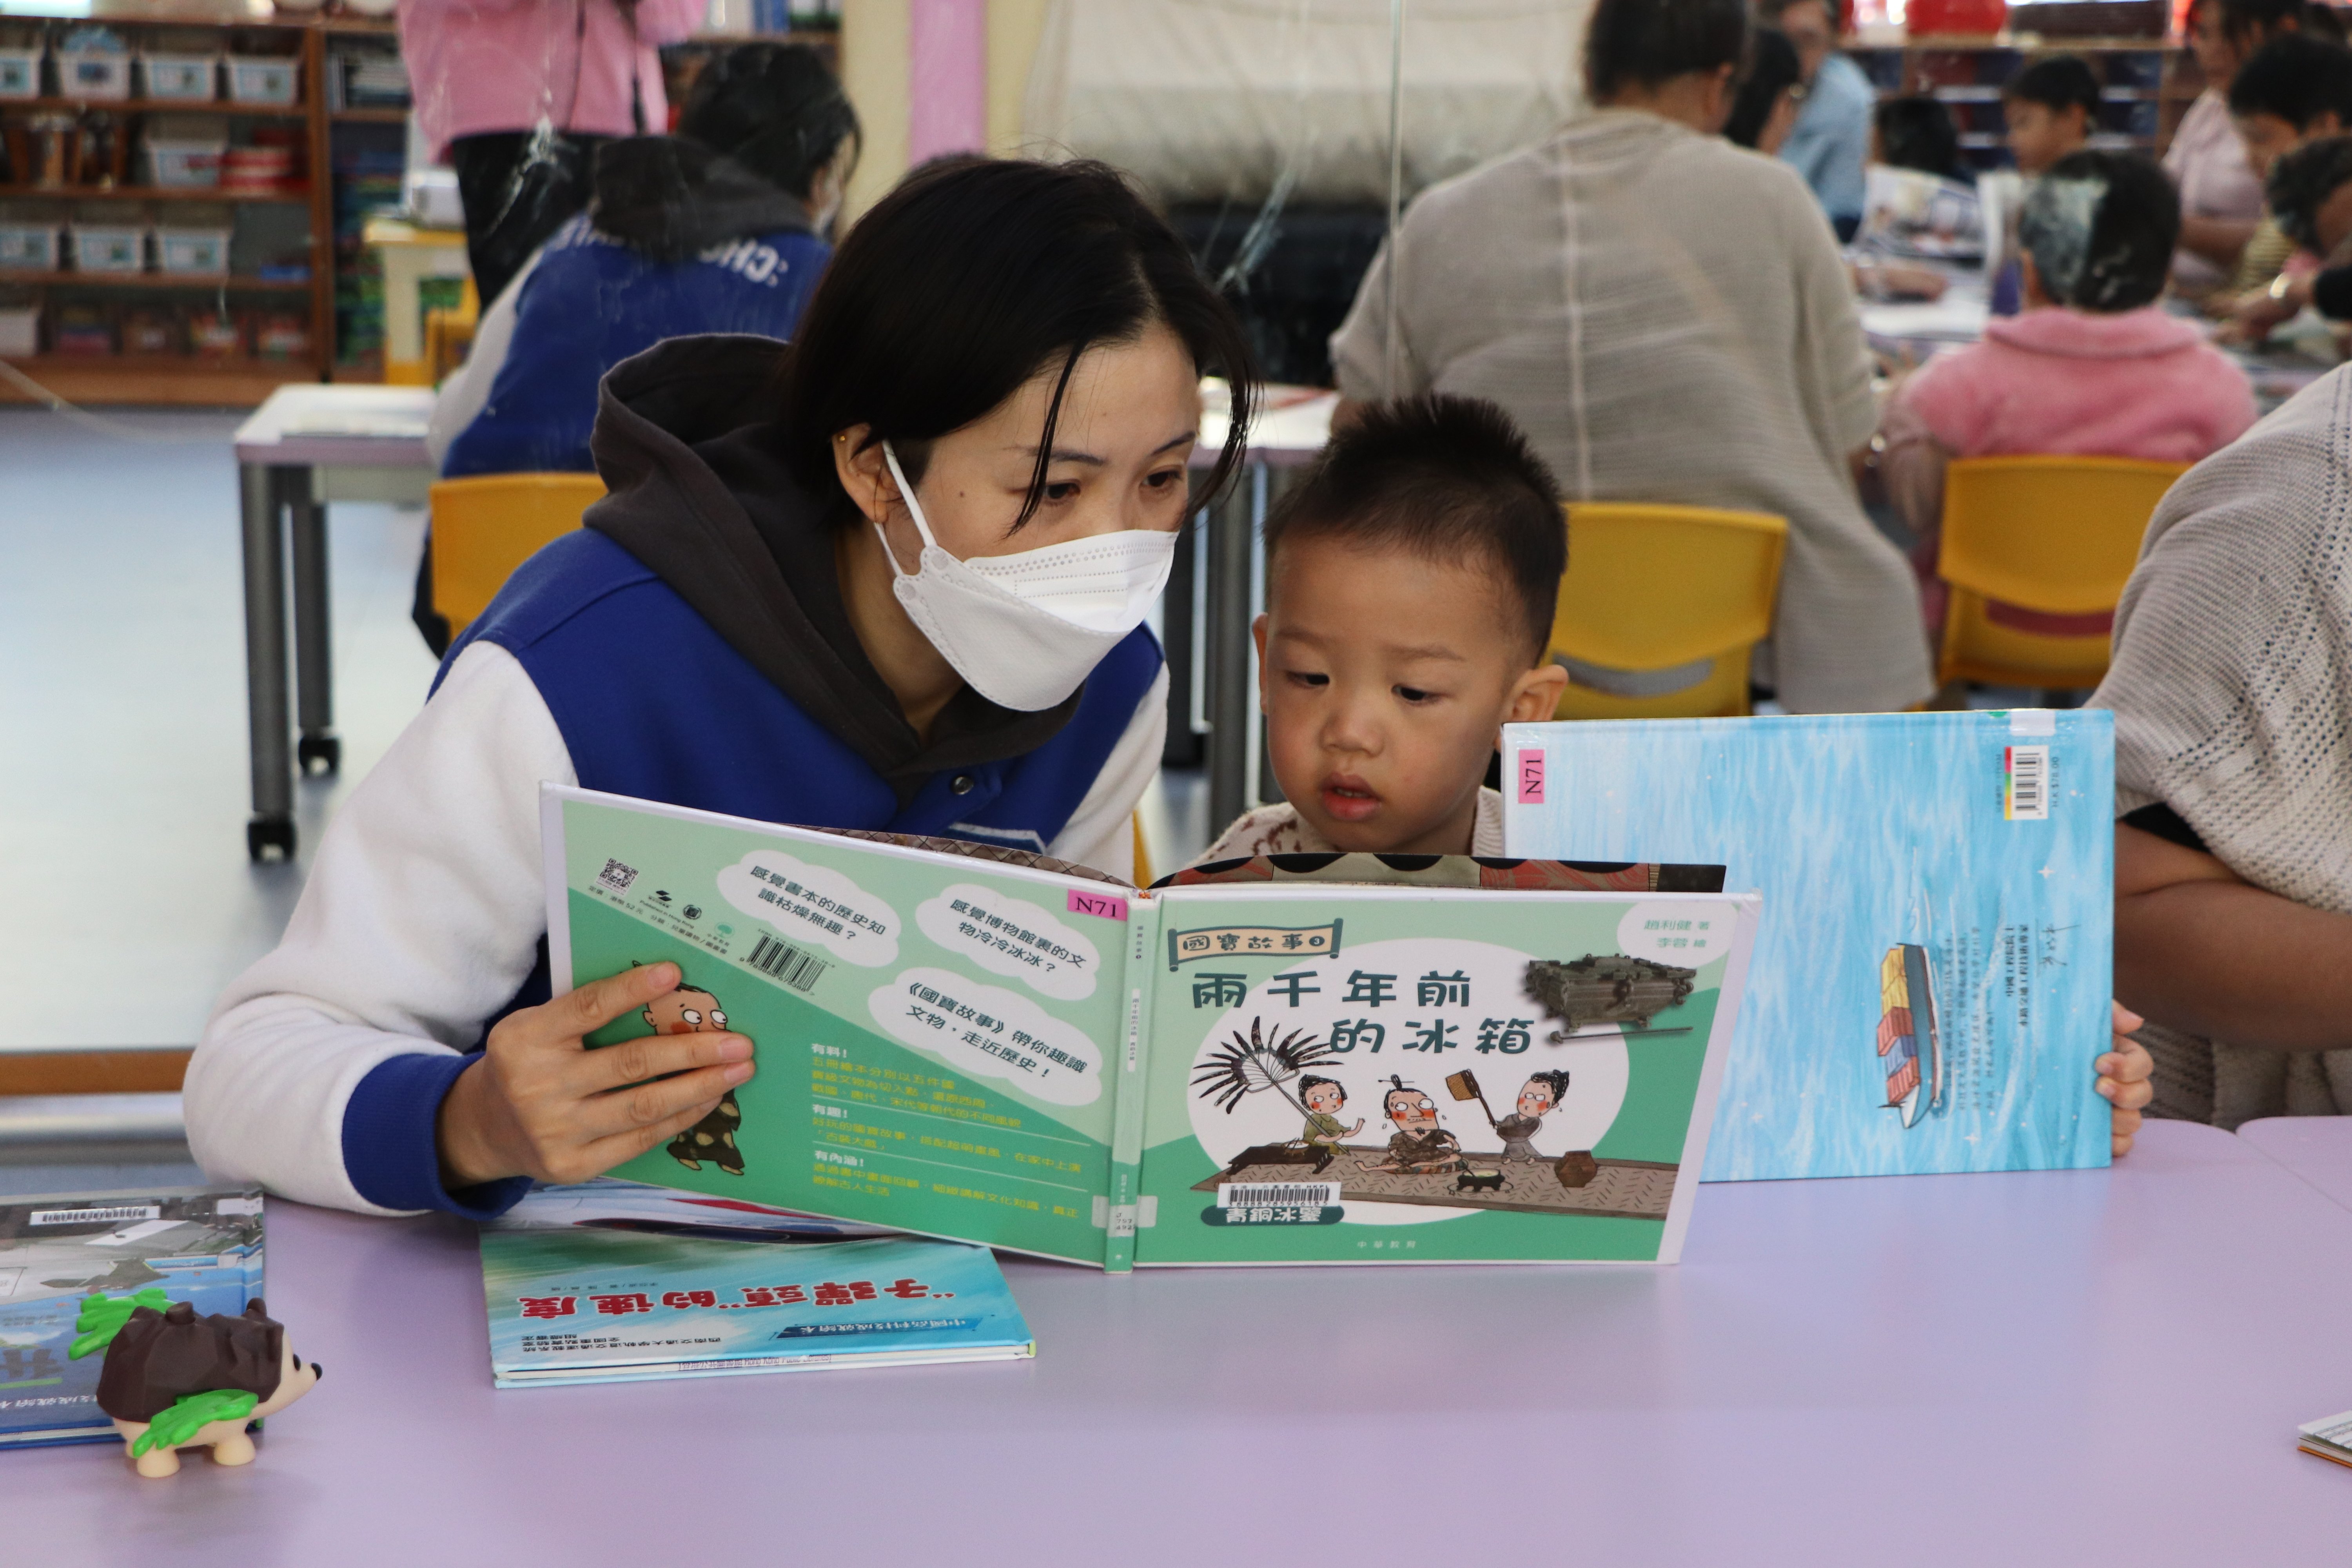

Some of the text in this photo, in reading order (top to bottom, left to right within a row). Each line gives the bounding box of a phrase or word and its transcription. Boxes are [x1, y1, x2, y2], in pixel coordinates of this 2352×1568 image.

[1525, 758, 1542, 795] N71
[750, 866, 886, 935] 感覺書本的歷史知
[757, 888, 857, 940] 識枯燥無趣？
[1075, 897, 1119, 917] N71
[950, 899, 1087, 968] 感覺博物館裏的文
[958, 921, 1056, 972] 物冷冷冰冰？
[1183, 933, 1304, 952] 國寶故事
[1192, 970, 1471, 1008] 兩千年前
[906, 1005, 1050, 1078] 文物，走近歷史！
[1330, 1018, 1535, 1055] 的冰箱
